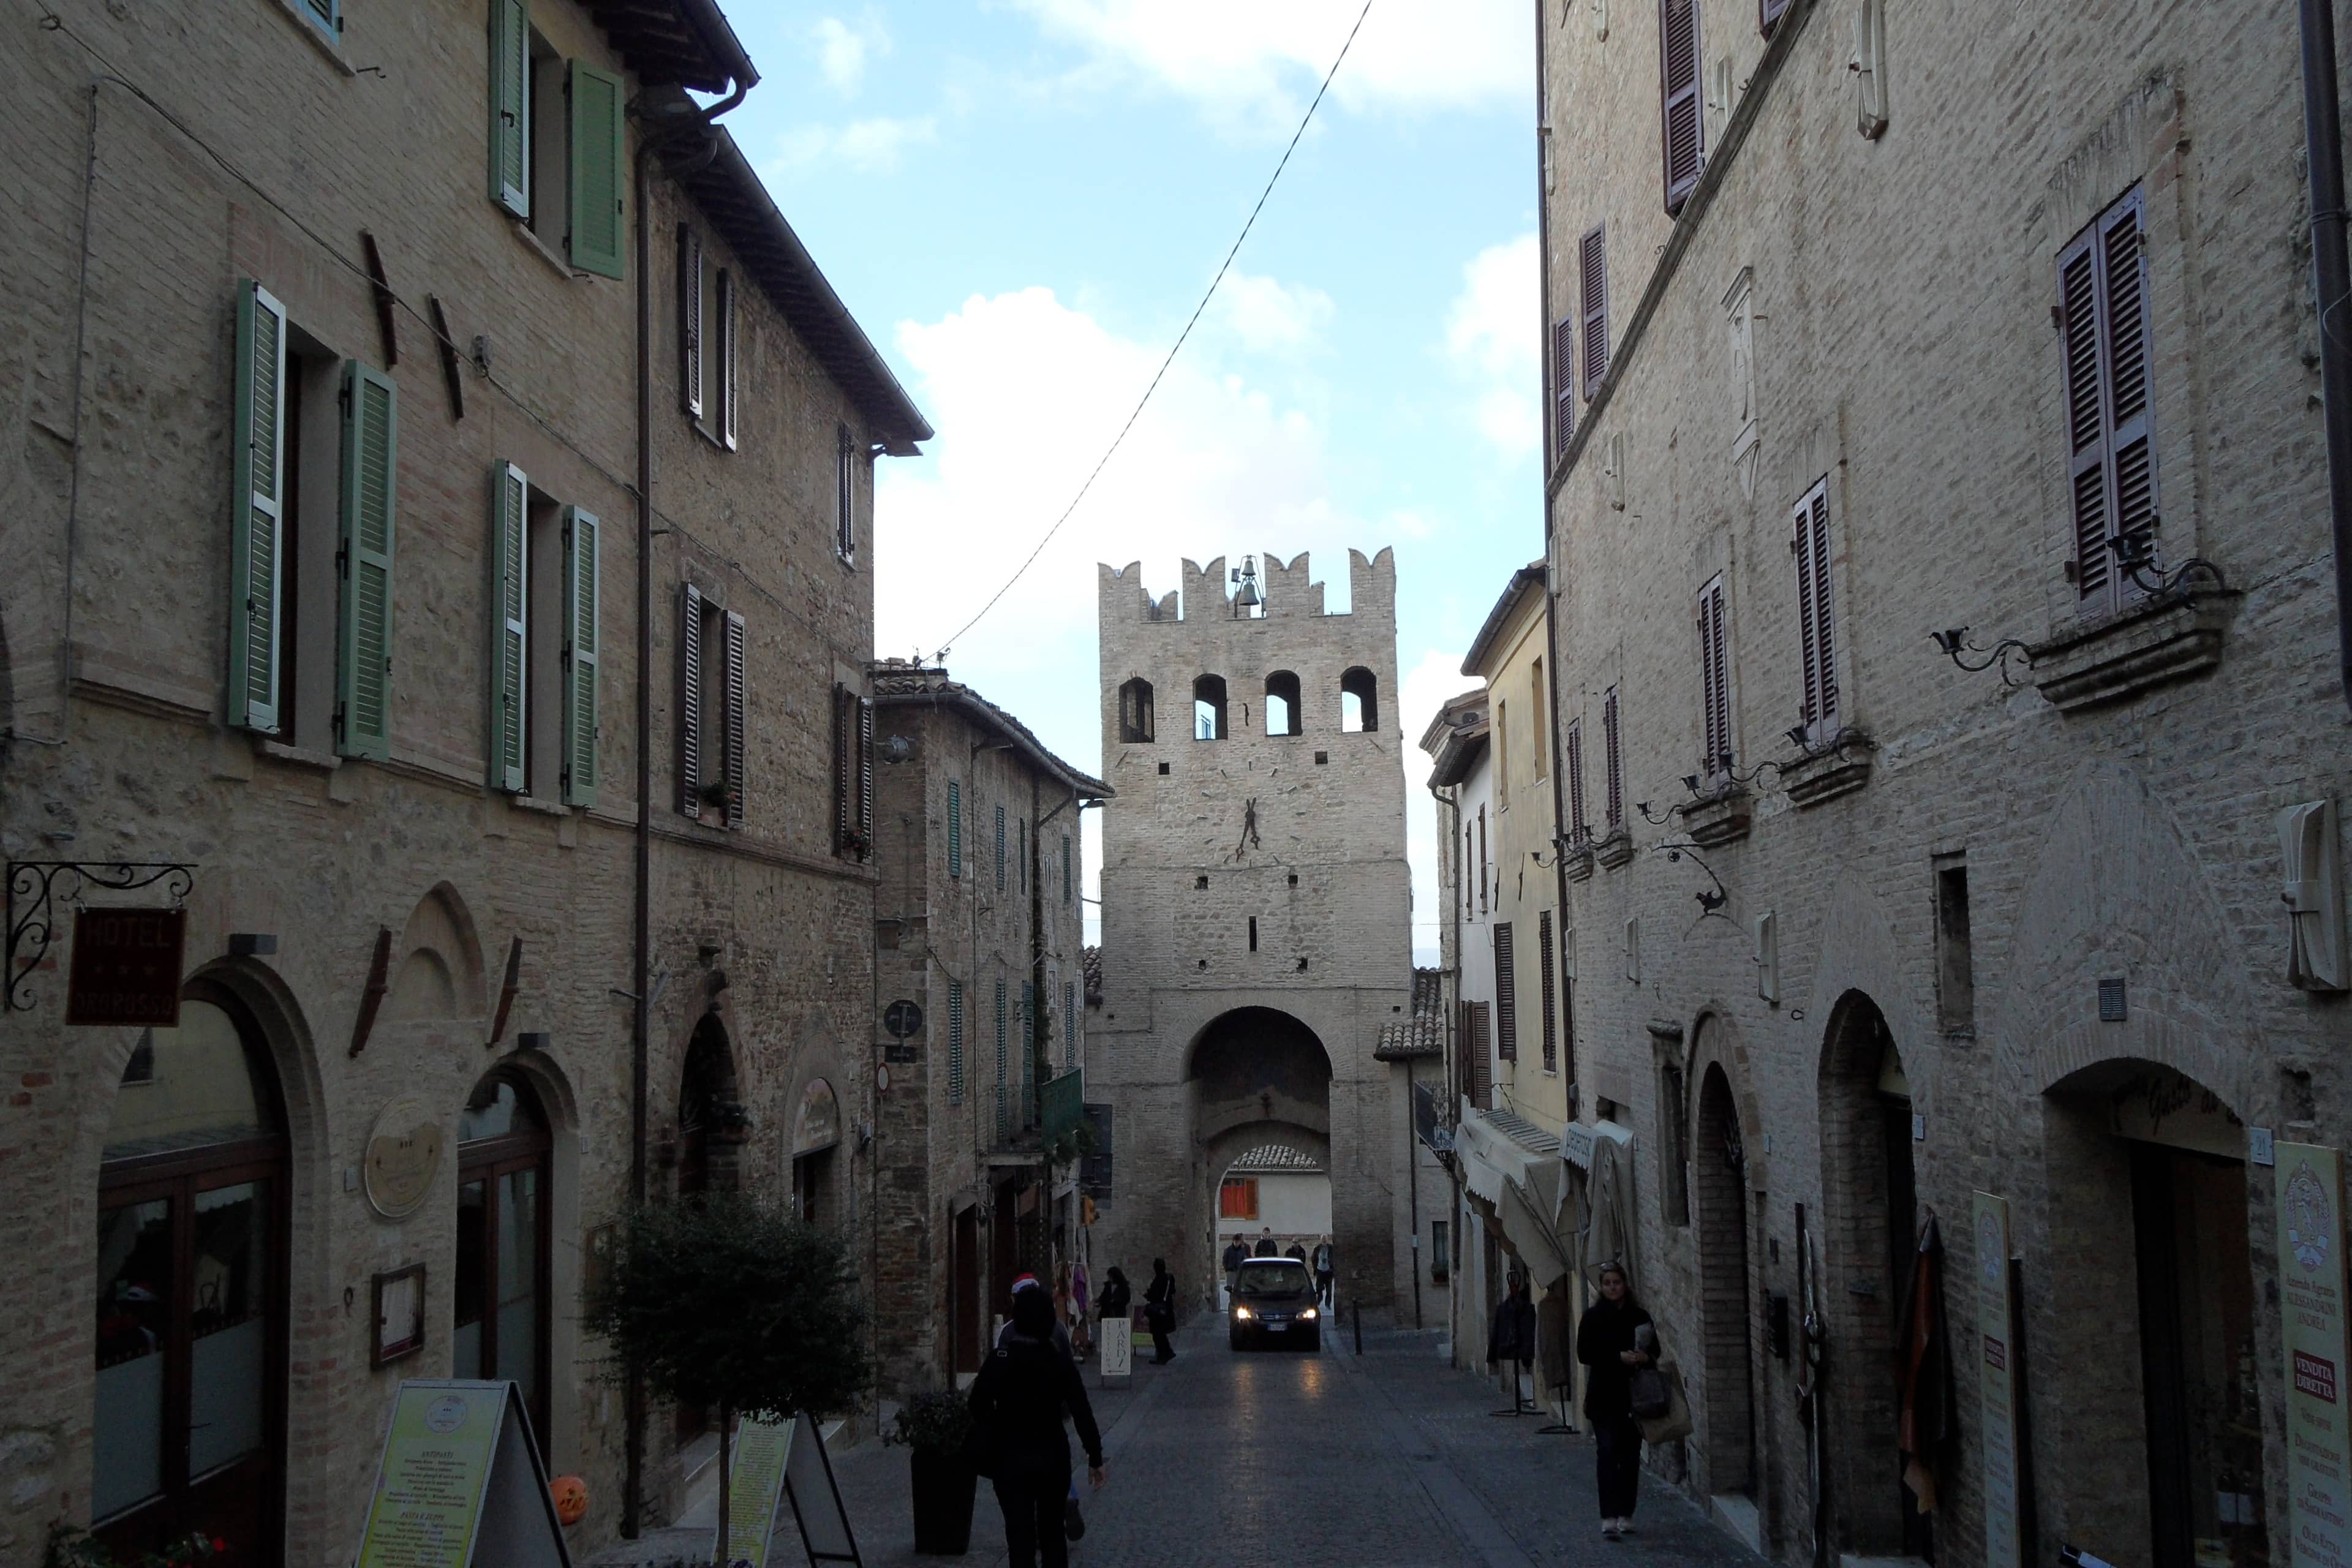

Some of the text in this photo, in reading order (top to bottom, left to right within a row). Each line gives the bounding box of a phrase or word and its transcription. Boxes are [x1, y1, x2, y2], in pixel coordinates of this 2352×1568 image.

[83, 916, 172, 948] HOTEL
[2296, 1357, 2333, 1382] VENDITA
[2296, 1373, 2334, 1398] DIRETTA
